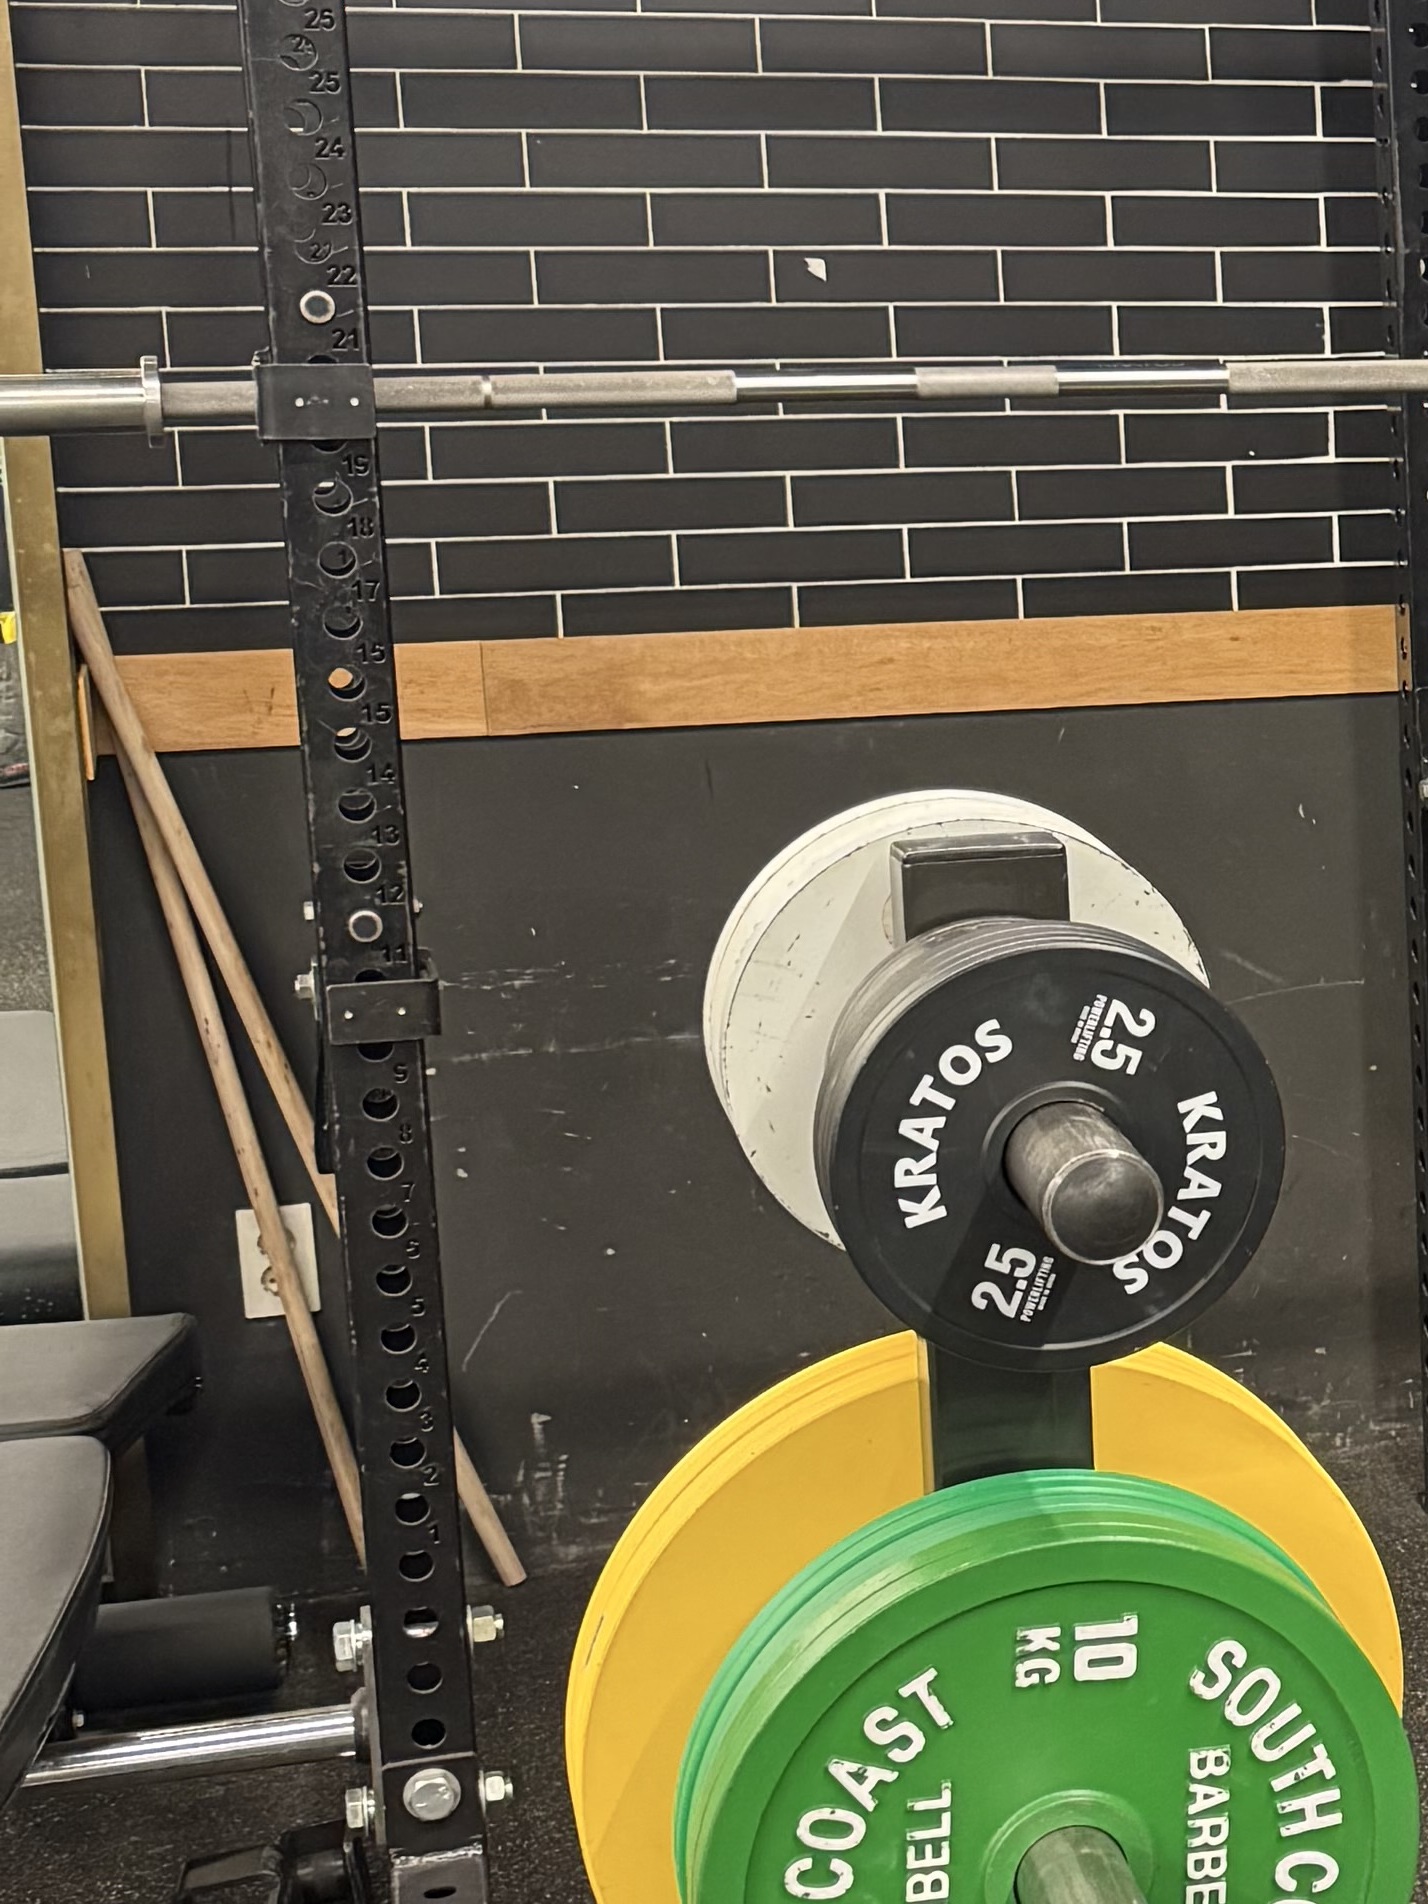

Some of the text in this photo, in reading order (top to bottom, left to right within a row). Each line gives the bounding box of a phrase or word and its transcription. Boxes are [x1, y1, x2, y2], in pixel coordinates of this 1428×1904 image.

[309, 70, 341, 94] 25
[315, 137, 345, 159] 24
[321, 202, 353, 226] 23
[326, 265, 358, 288] 22
[331, 327, 360, 351] 21
[351, 579, 381, 603] 17
[375, 883, 406, 906] 12
[1090, 998, 1156, 1076] 2.5
[893, 1018, 1014, 1229] KRATOS
[400, 1182, 417, 1203] 7
[1112, 1090, 1228, 1296] KRATOS
[970, 1242, 1037, 1319] 2.5
[421, 1464, 441, 1487] 2
[427, 1521, 441, 1545] 1
[1013, 1623, 1062, 1690] KG
[1073, 1611, 1139, 1683] 10
[1188, 1637, 1343, 1838] SOUTH
[783, 1665, 955, 1901] COAST
